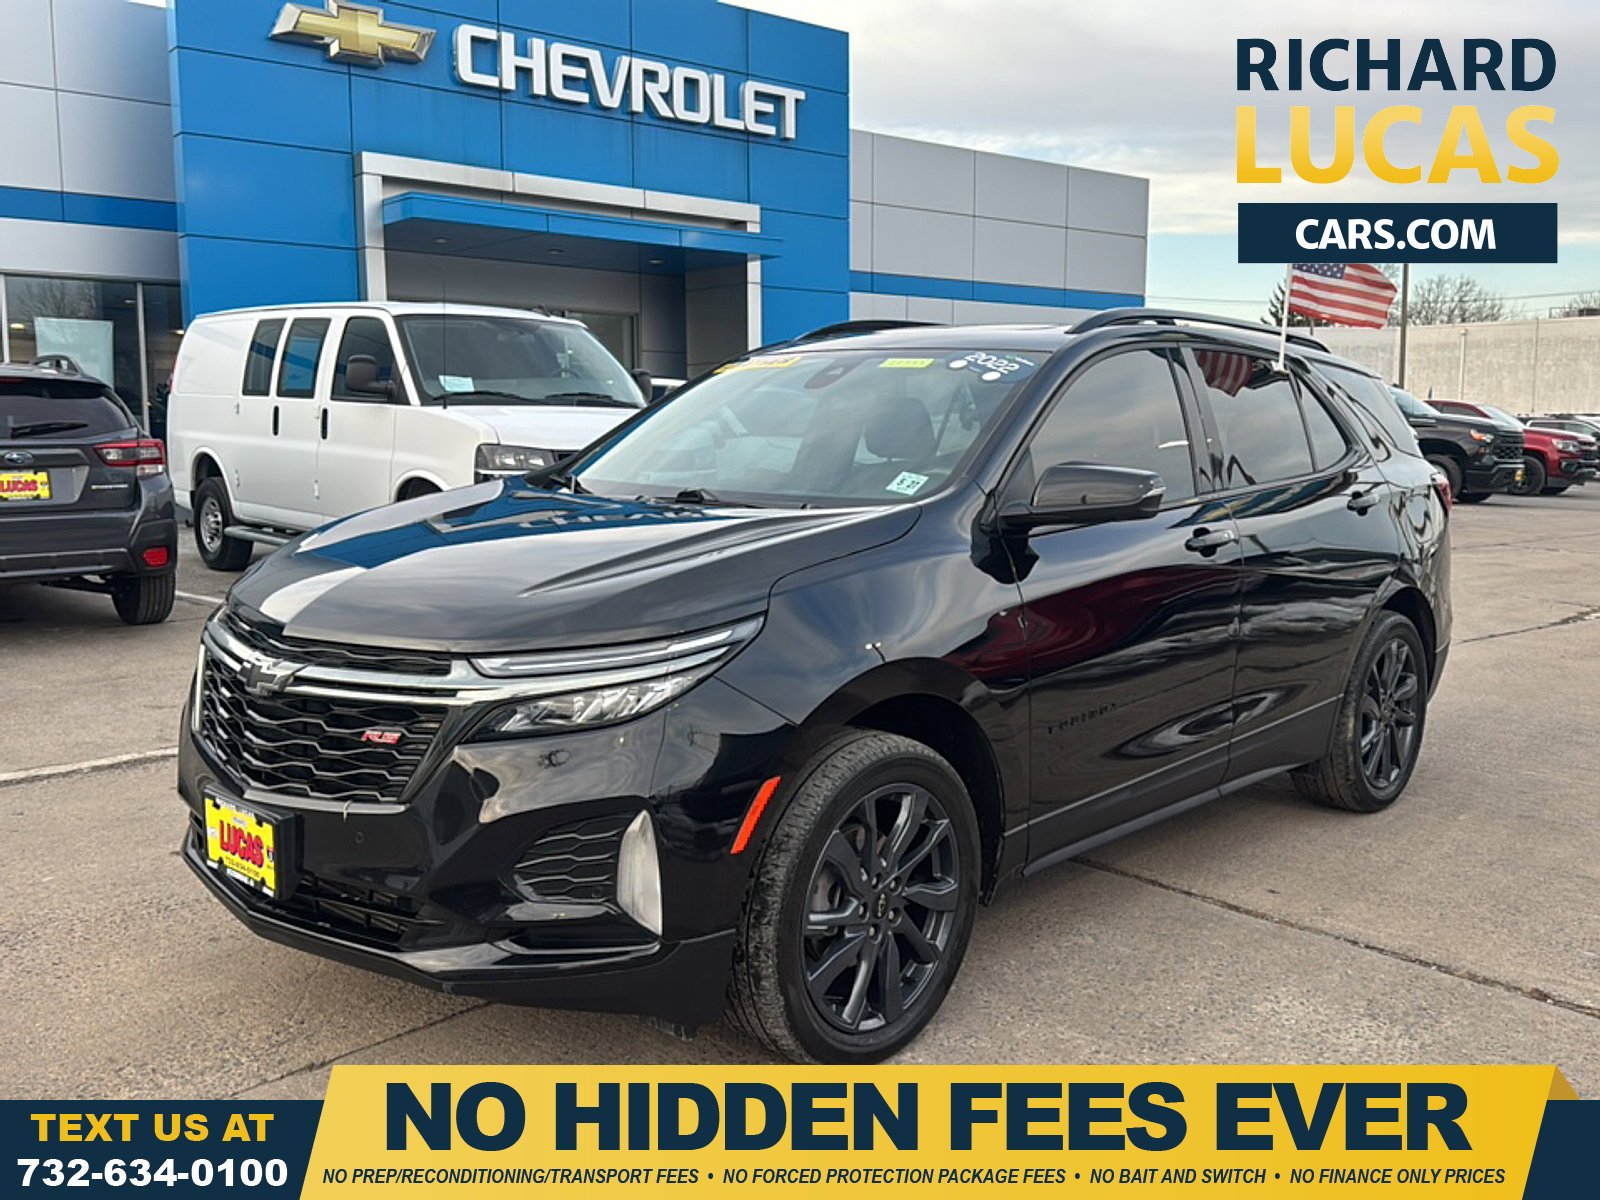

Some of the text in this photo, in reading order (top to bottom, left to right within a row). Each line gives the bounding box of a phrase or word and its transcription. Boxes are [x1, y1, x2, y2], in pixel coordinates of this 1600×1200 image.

[453, 23, 807, 139] CHEVROLET
[964, 352, 1019, 374] 2022
[362, 730, 401, 744] RS
[220, 820, 264, 868] LUCAS
